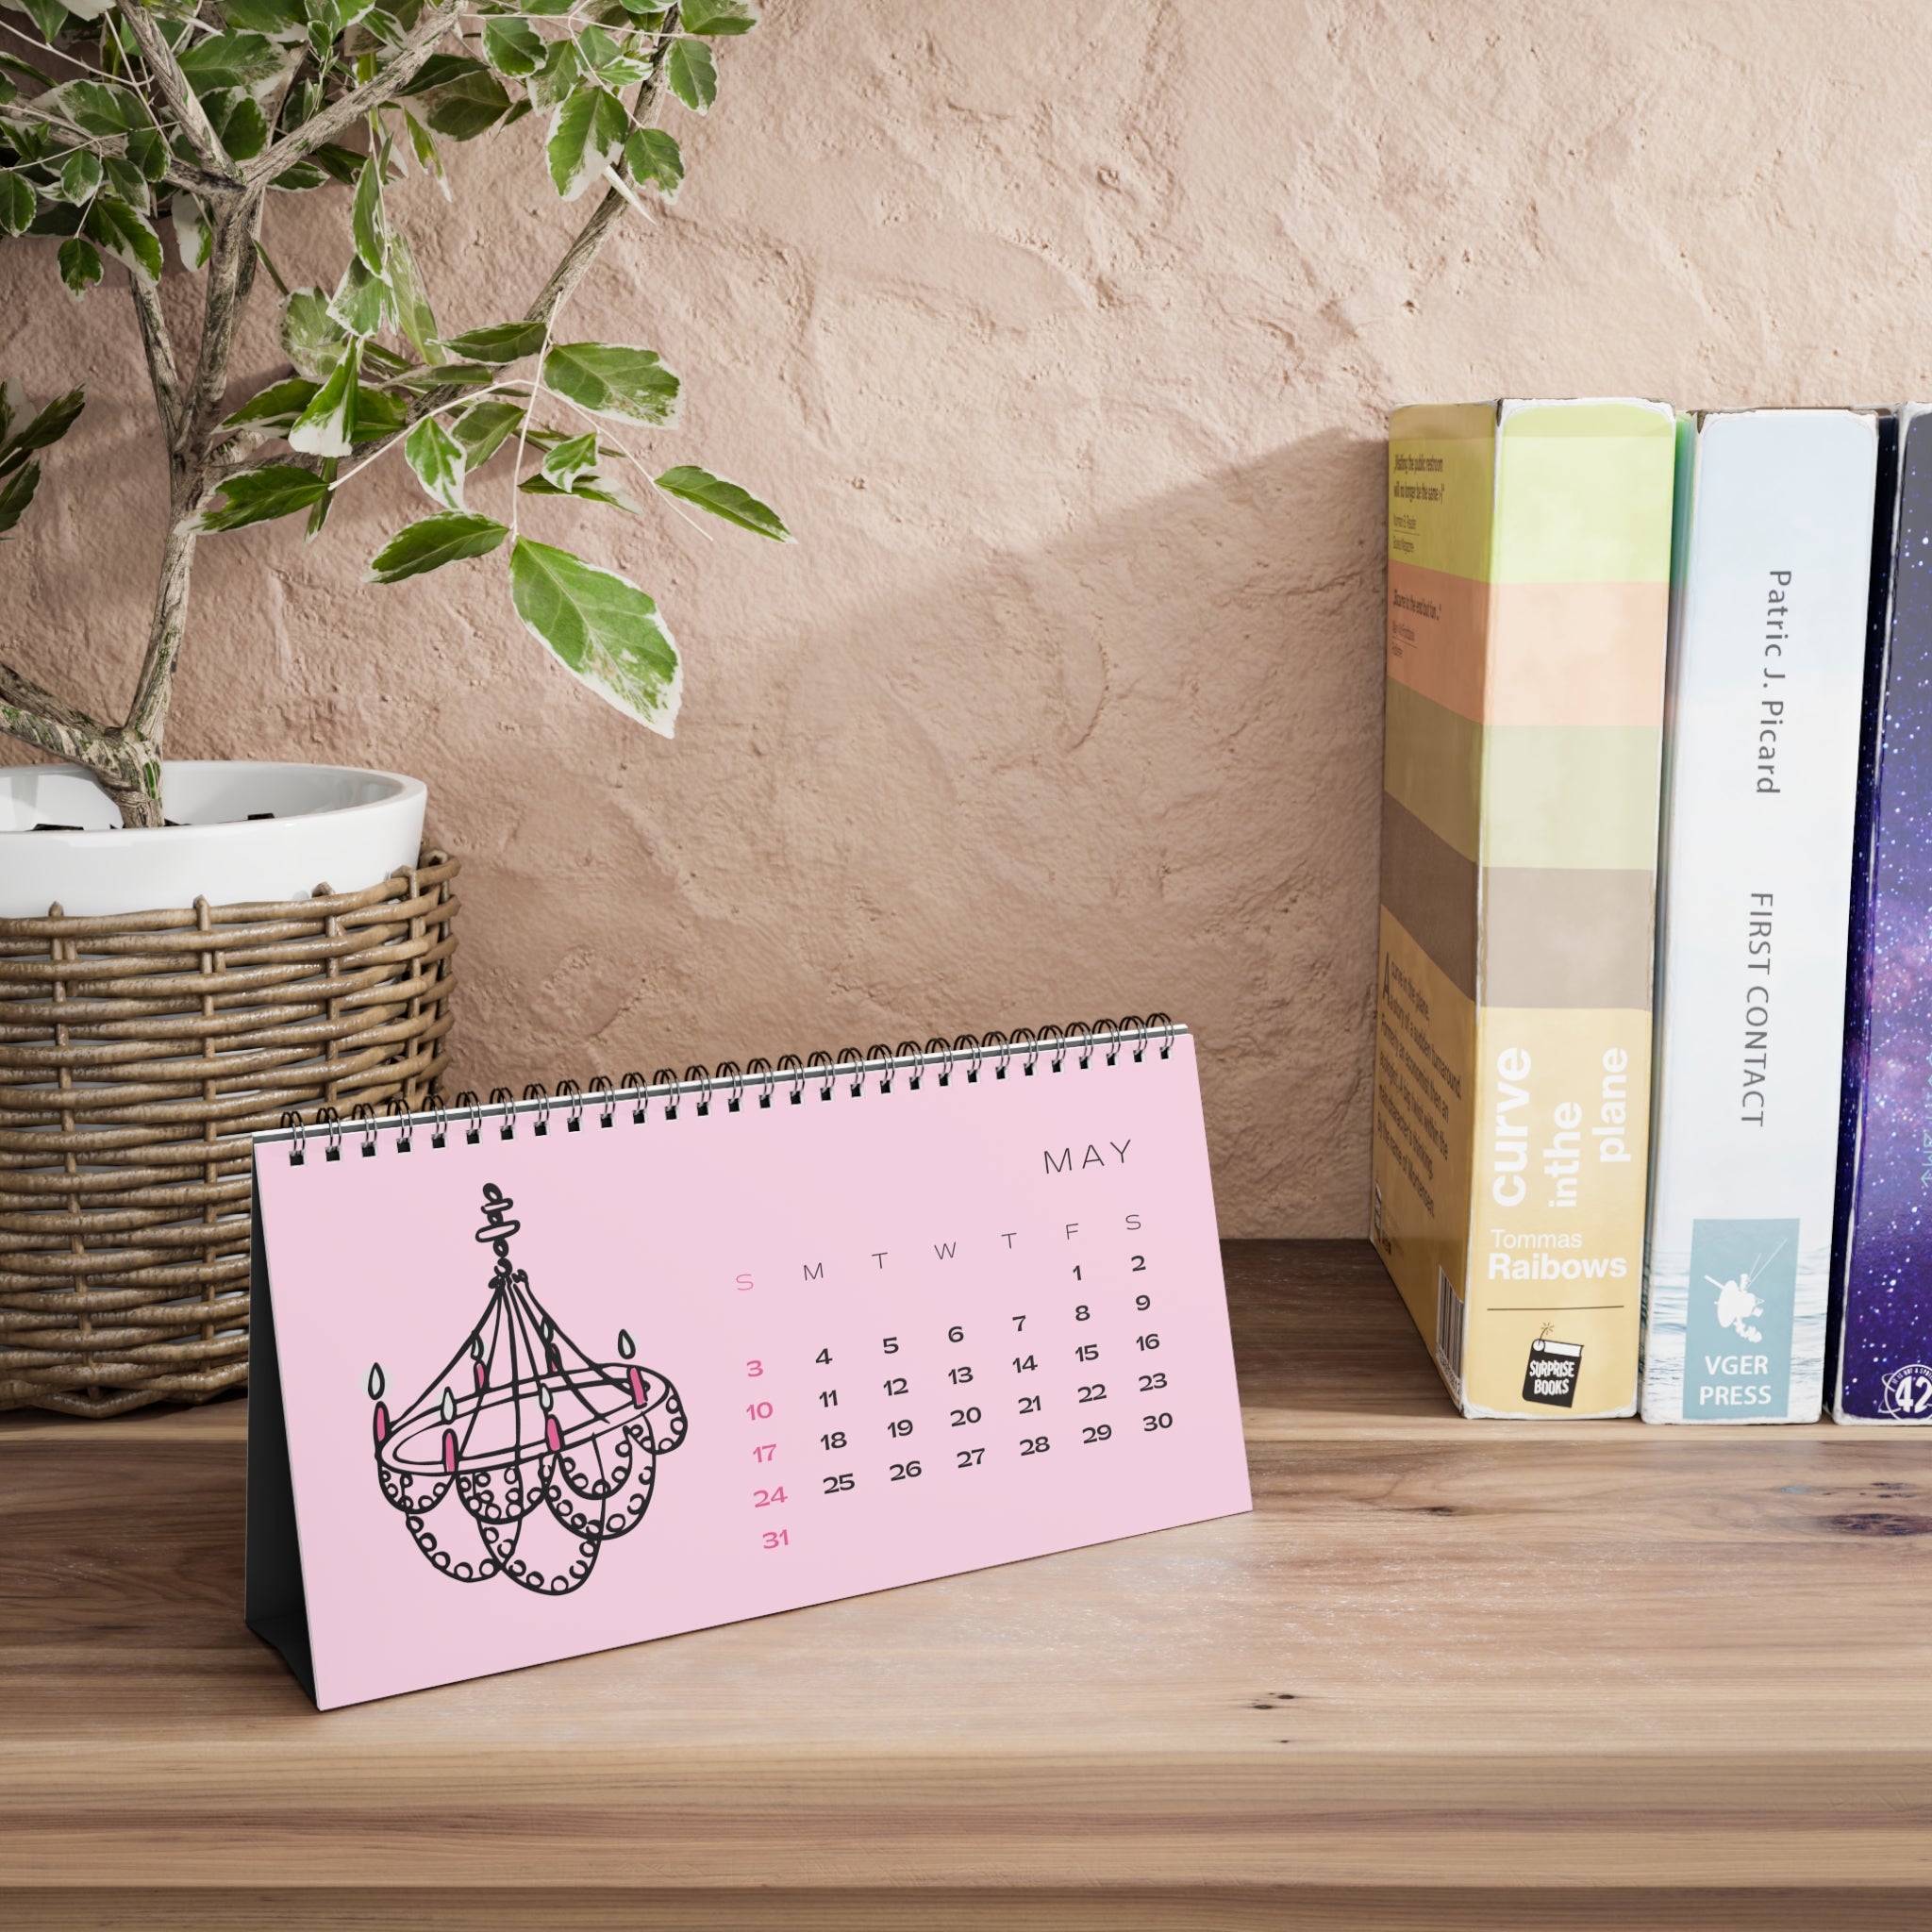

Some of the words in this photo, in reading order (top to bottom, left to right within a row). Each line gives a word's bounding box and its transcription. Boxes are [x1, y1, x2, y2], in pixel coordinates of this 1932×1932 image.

[1763, 569, 1793, 658] Patric
[1762, 667, 1786, 688] J.
[1756, 700, 1785, 794] Picard
[1745, 891, 1774, 976] FIRST
[1739, 985, 1771, 1127] CONTACT
[1491, 1046, 1532, 1208] curve
[1591, 1046, 1632, 1163] plane
[1043, 1139, 1133, 1174] MAY
[735, 1274, 754, 1291] S
[803, 1261, 824, 1282] M
[871, 1252, 889, 1270] T
[933, 1241, 957, 1260] W
[1000, 1232, 1018, 1250] T
[1065, 1223, 1079, 1241] F
[1124, 1213, 1141, 1231] S
[1072, 1264, 1082, 1282] 1
[1130, 1254, 1147, 1273] 2
[1487, 1251, 1628, 1281] Raibows
[1490, 1228, 1584, 1250] Tommas
[746, 1359, 764, 1378] 3
[815, 1347, 834, 1365] 4
[882, 1336, 900, 1355] 5
[947, 1325, 965, 1343] 6
[1011, 1314, 1027, 1333] 7
[1074, 1304, 1091, 1322] 8
[1135, 1293, 1151, 1311] 9
[745, 1401, 774, 1422] 10
[818, 1389, 839, 1408] 11
[882, 1376, 909, 1397] 12
[947, 1365, 974, 1386] 13
[1011, 1354, 1039, 1374] 14
[1074, 1342, 1100, 1363] 15
[1135, 1332, 1160, 1352] 16
[1528, 1358, 1575, 1378] SURPRISE
[1533, 1378, 1570, 1396] BOOKS
[1704, 1355, 1769, 1375] VGER
[1894, 1375, 1932, 1413] 42
[752, 1443, 777, 1463] 17
[820, 1430, 848, 1452] 18
[887, 1418, 914, 1439] 19
[949, 1406, 982, 1428] 20
[1017, 1394, 1041, 1415] 21
[1076, 1383, 1108, 1404] 22
[1138, 1372, 1168, 1392] 23
[1698, 1384, 1772, 1406] PRESS
[753, 1486, 789, 1508] 24
[822, 1472, 856, 1495] 25
[889, 1459, 923, 1482] 26
[956, 1447, 986, 1469] 27
[1019, 1435, 1051, 1457] 28
[1081, 1424, 1112, 1445] 29
[1142, 1411, 1174, 1433] 30
[762, 1528, 790, 1550] 31
